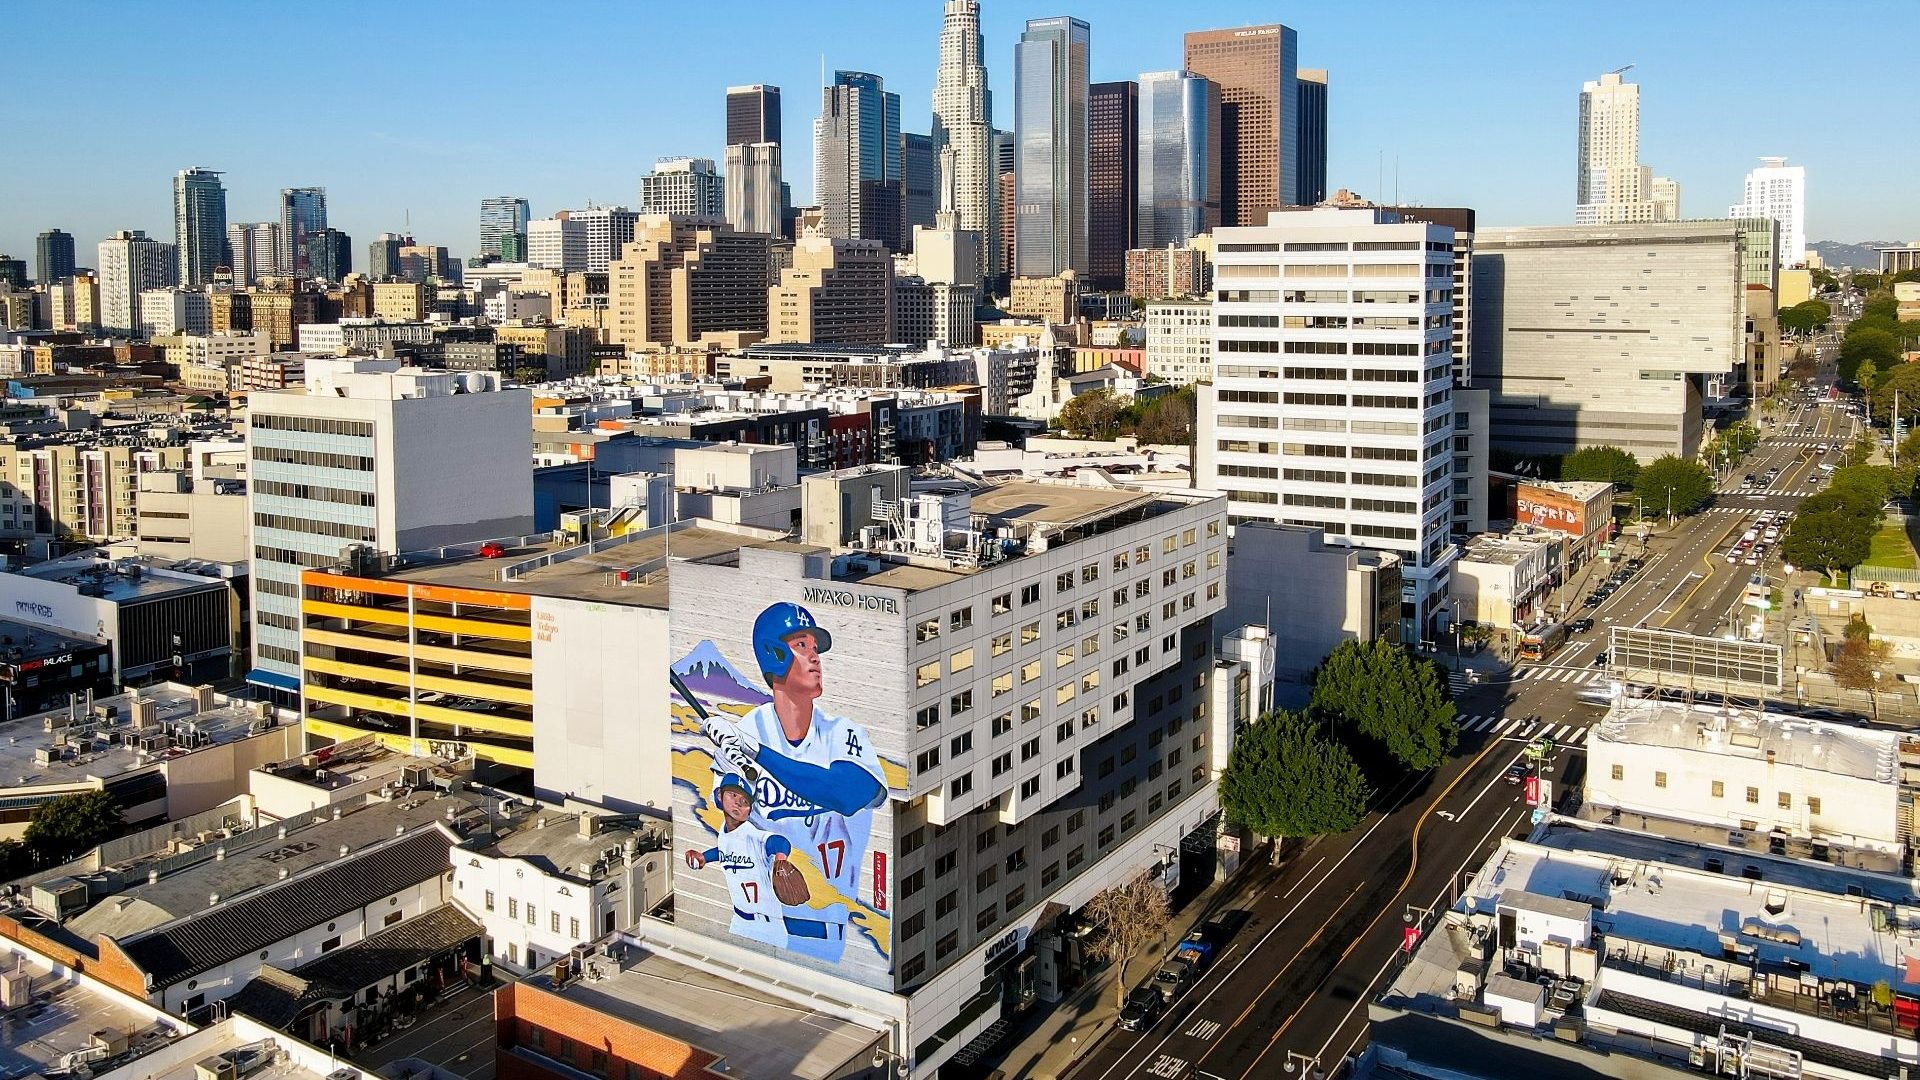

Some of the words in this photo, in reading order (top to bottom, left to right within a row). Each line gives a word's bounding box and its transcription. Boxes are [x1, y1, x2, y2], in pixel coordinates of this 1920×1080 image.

[803, 586, 854, 608] MIYAKO
[857, 594, 900, 616] HOTEL
[795, 605, 811, 628] LA
[43, 653, 73, 667] PALACE
[845, 728, 863, 758] LA
[718, 849, 753, 874] Dodgers
[817, 839, 845, 880] 17
[740, 881, 759, 904] 17
[984, 929, 1019, 963] MIYAKO
[1145, 1054, 1189, 1080] HERE
